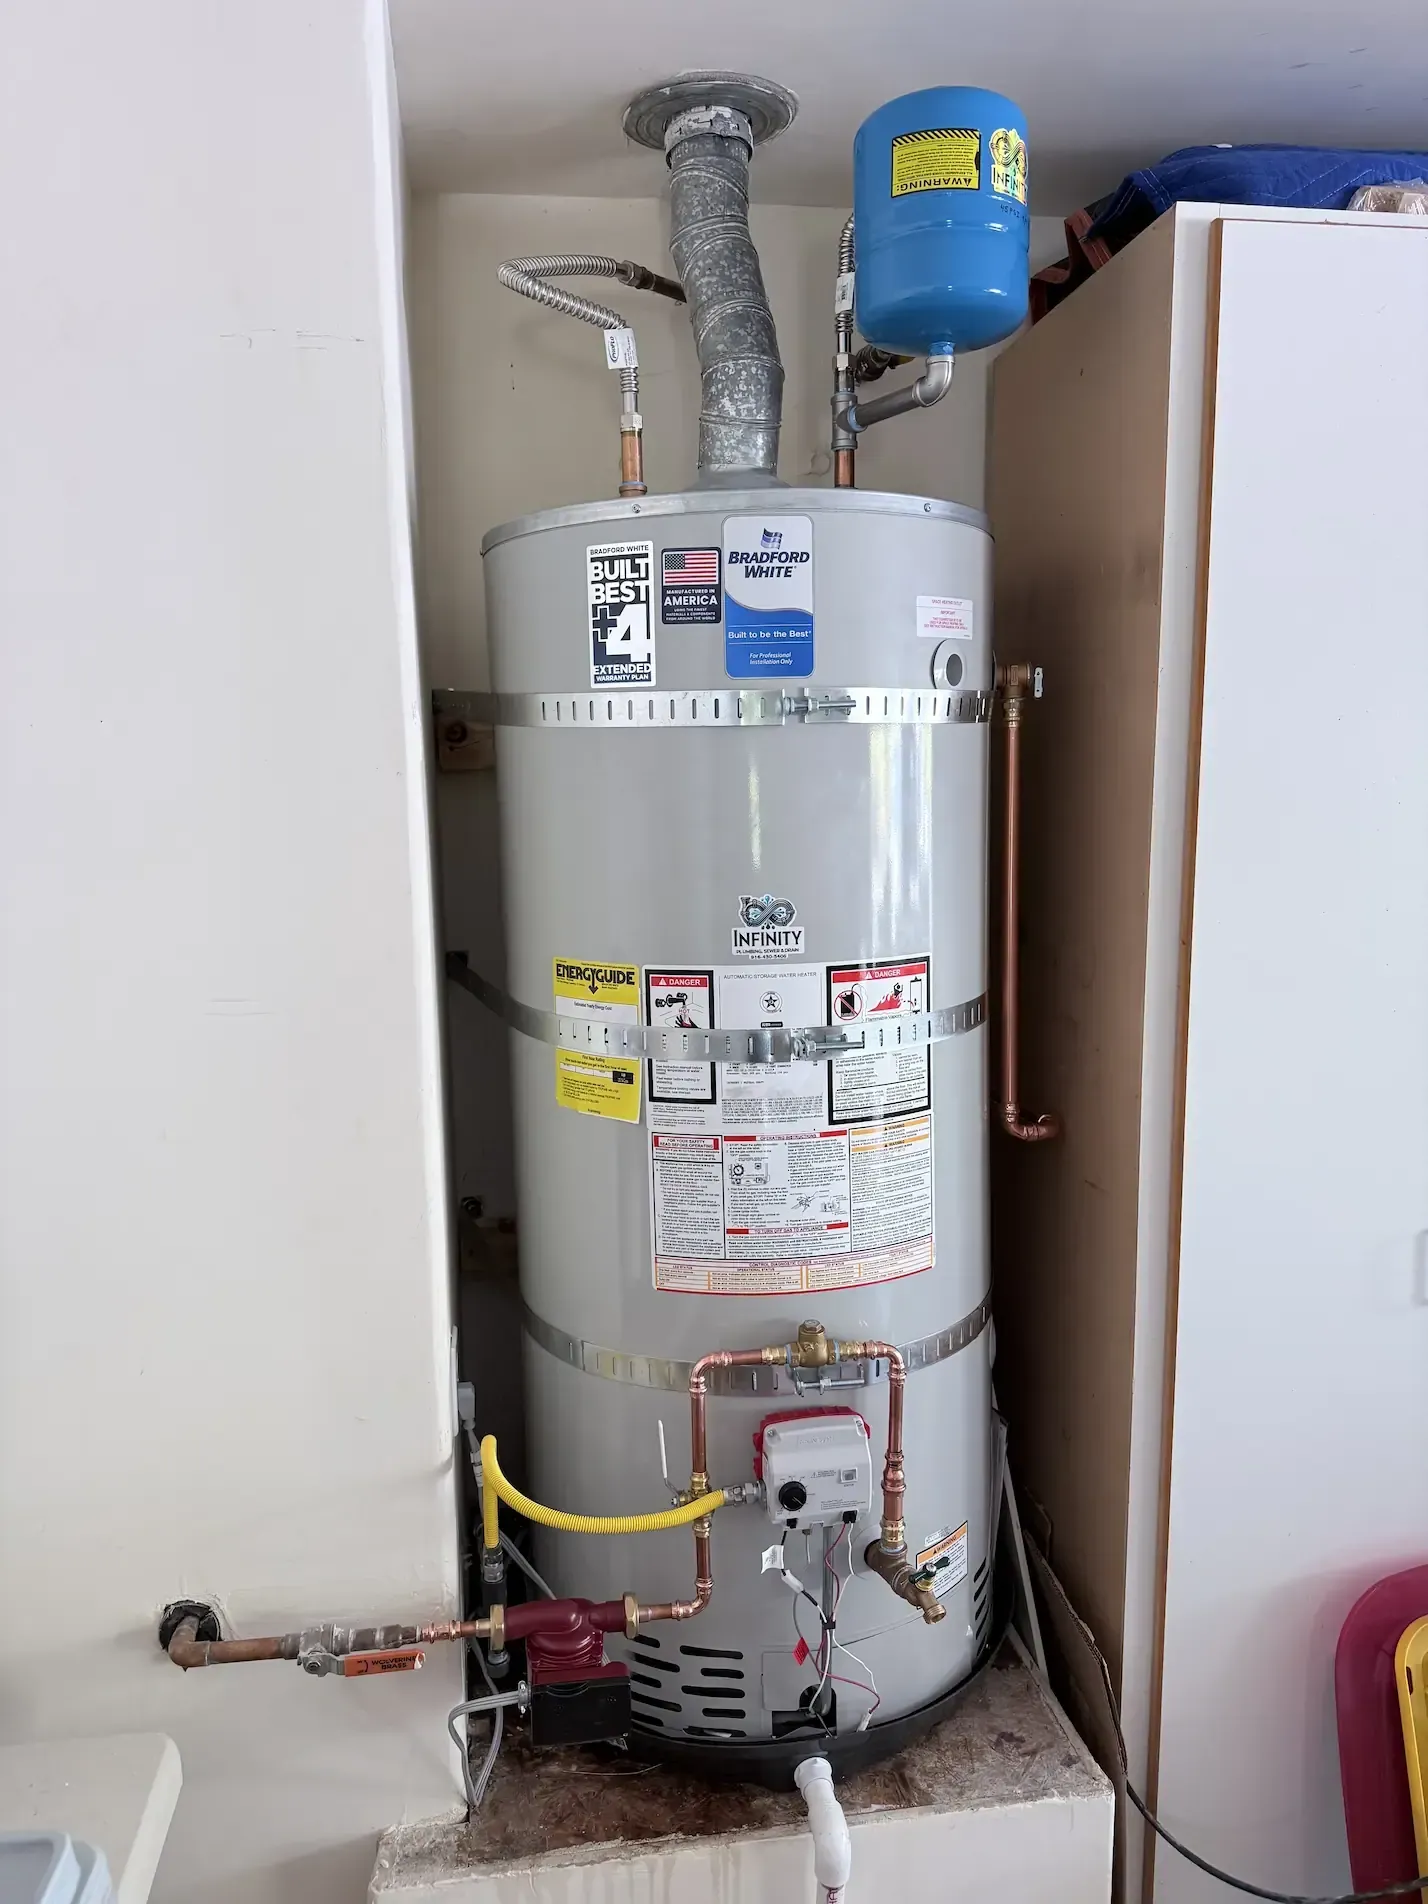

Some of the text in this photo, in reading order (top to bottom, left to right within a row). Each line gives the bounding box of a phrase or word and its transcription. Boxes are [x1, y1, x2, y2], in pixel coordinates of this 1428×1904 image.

[896, 178, 962, 192] WARNING:
[590, 547, 625, 556] BRADFORD
[728, 551, 810, 564] BRADFORD
[591, 558, 650, 580] BUILT
[592, 580, 650, 604] BEST
[664, 595, 718, 606] AMERICA
[728, 631, 747, 639] Built
[749, 631, 758, 639] to
[760, 631, 771, 639] be
[773, 630, 787, 638] the
[780, 658, 793, 666] Only
[594, 663, 651, 676] EXTENDED
[734, 930, 802, 947] INFINITY
[556, 963, 635, 986] ENERGYGUIDE
[874, 969, 901, 978] DANGER
[936, 1535, 957, 1552] WARNING
[371, 1655, 416, 1666] WOLVERINE
[381, 1662, 407, 1670] BRASS
